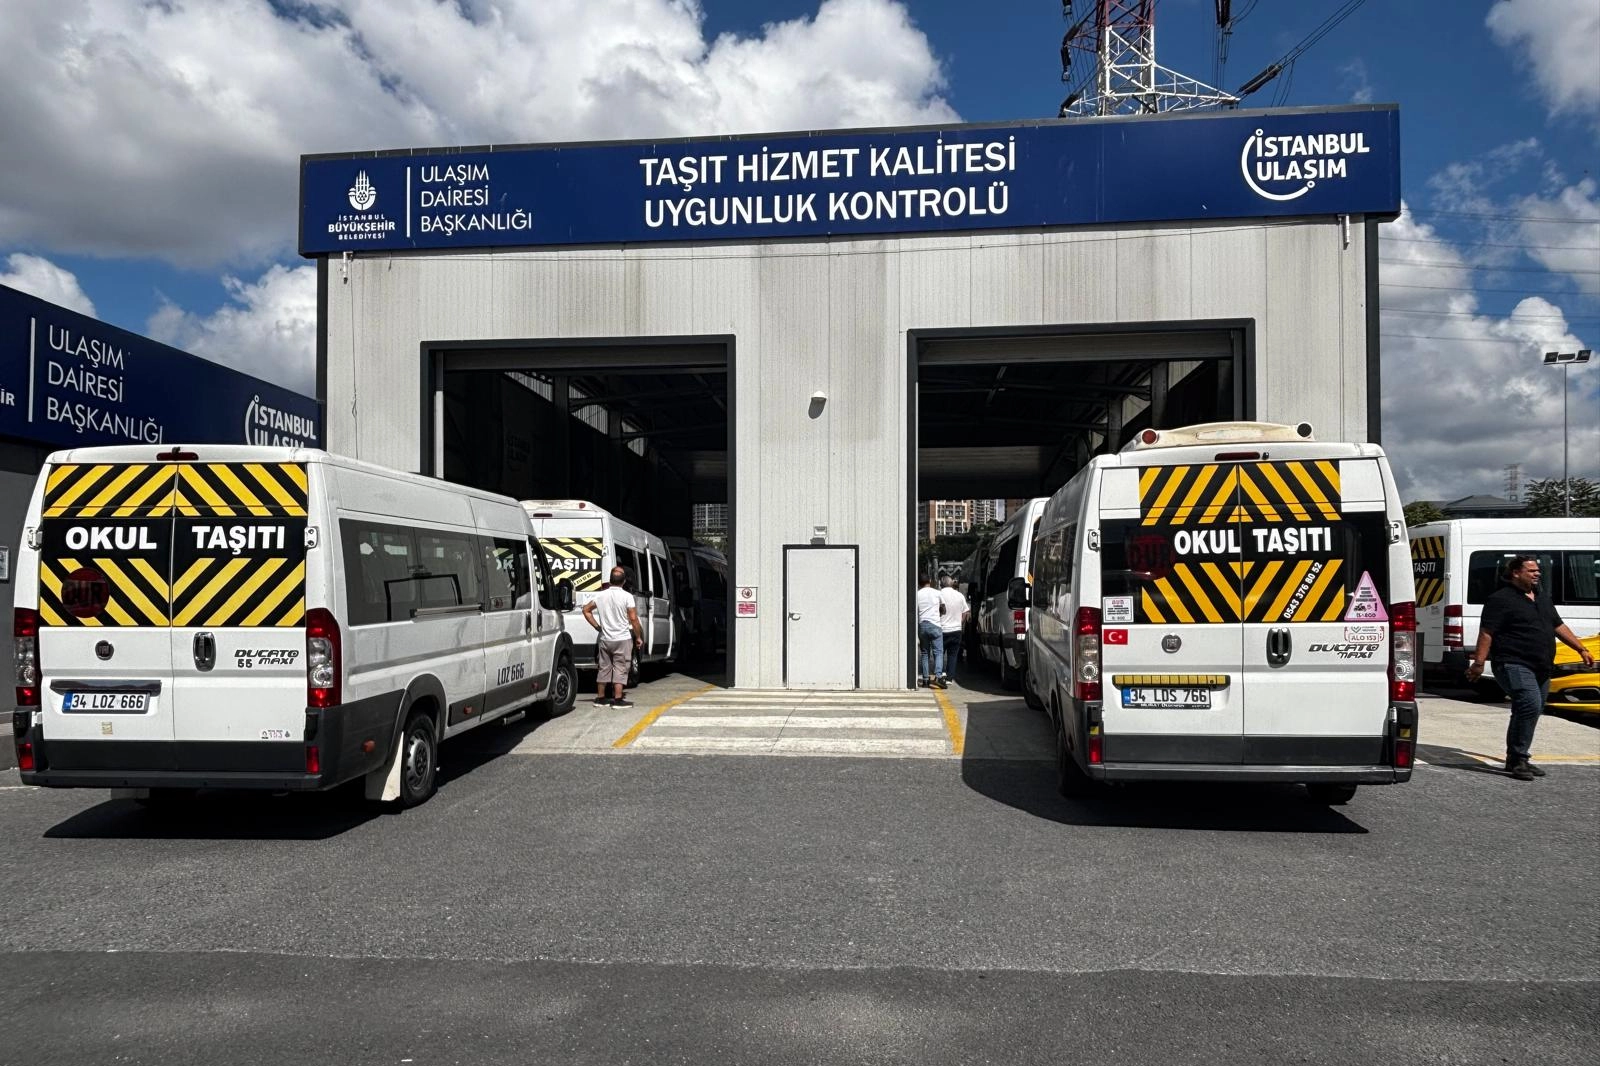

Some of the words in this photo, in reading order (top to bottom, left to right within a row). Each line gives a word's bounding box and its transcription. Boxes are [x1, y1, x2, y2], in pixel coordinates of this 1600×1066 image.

[1255, 129, 1370, 157] İSTANBUL
[421, 164, 490, 186] ULAŞIM
[640, 155, 728, 192] TAŞIT
[738, 146, 860, 184] HİZMET
[870, 136, 1016, 177] KALİTESİ
[1256, 159, 1347, 188] ULAŞIM
[421, 185, 489, 207] DAİRESİ
[645, 193, 817, 227] UYGUNLUK
[829, 181, 1010, 220] KONTROLÜ
[328, 220, 396, 233] BÜYÜKŞEHİR
[338, 213, 386, 221] İSTANBUL
[421, 209, 533, 236] BAŞKANLIĞI
[338, 232, 385, 240] BELEDİYESİ
[49, 324, 124, 370] ULAŞIM
[48, 360, 123, 403] DAİRESİ
[47, 396, 163, 444] BAŞKANLIĞI
[254, 394, 317, 440] İSTANBUL
[65, 526, 157, 550] OKUL
[191, 525, 285, 555] TAŞITI
[1174, 529, 1242, 555] OKUL
[1252, 527, 1332, 556] TAŞITI
[1413, 562, 1436, 574] TAŞITI
[1283, 599, 1300, 619] 0543
[1295, 583, 1309, 599] 376
[1305, 573, 1316, 584] 80
[1311, 562, 1323, 573] 52
[234, 649, 300, 658] DUCATO
[1308, 644, 1380, 652] DUCATO
[511, 662, 525, 681] 666
[72, 695, 87, 708] 34
[92, 695, 116, 708] LOZ
[121, 695, 144, 708] 666
[1130, 688, 1146, 702] 34
[1154, 688, 1177, 702] LDS
[1184, 688, 1207, 702] 766
